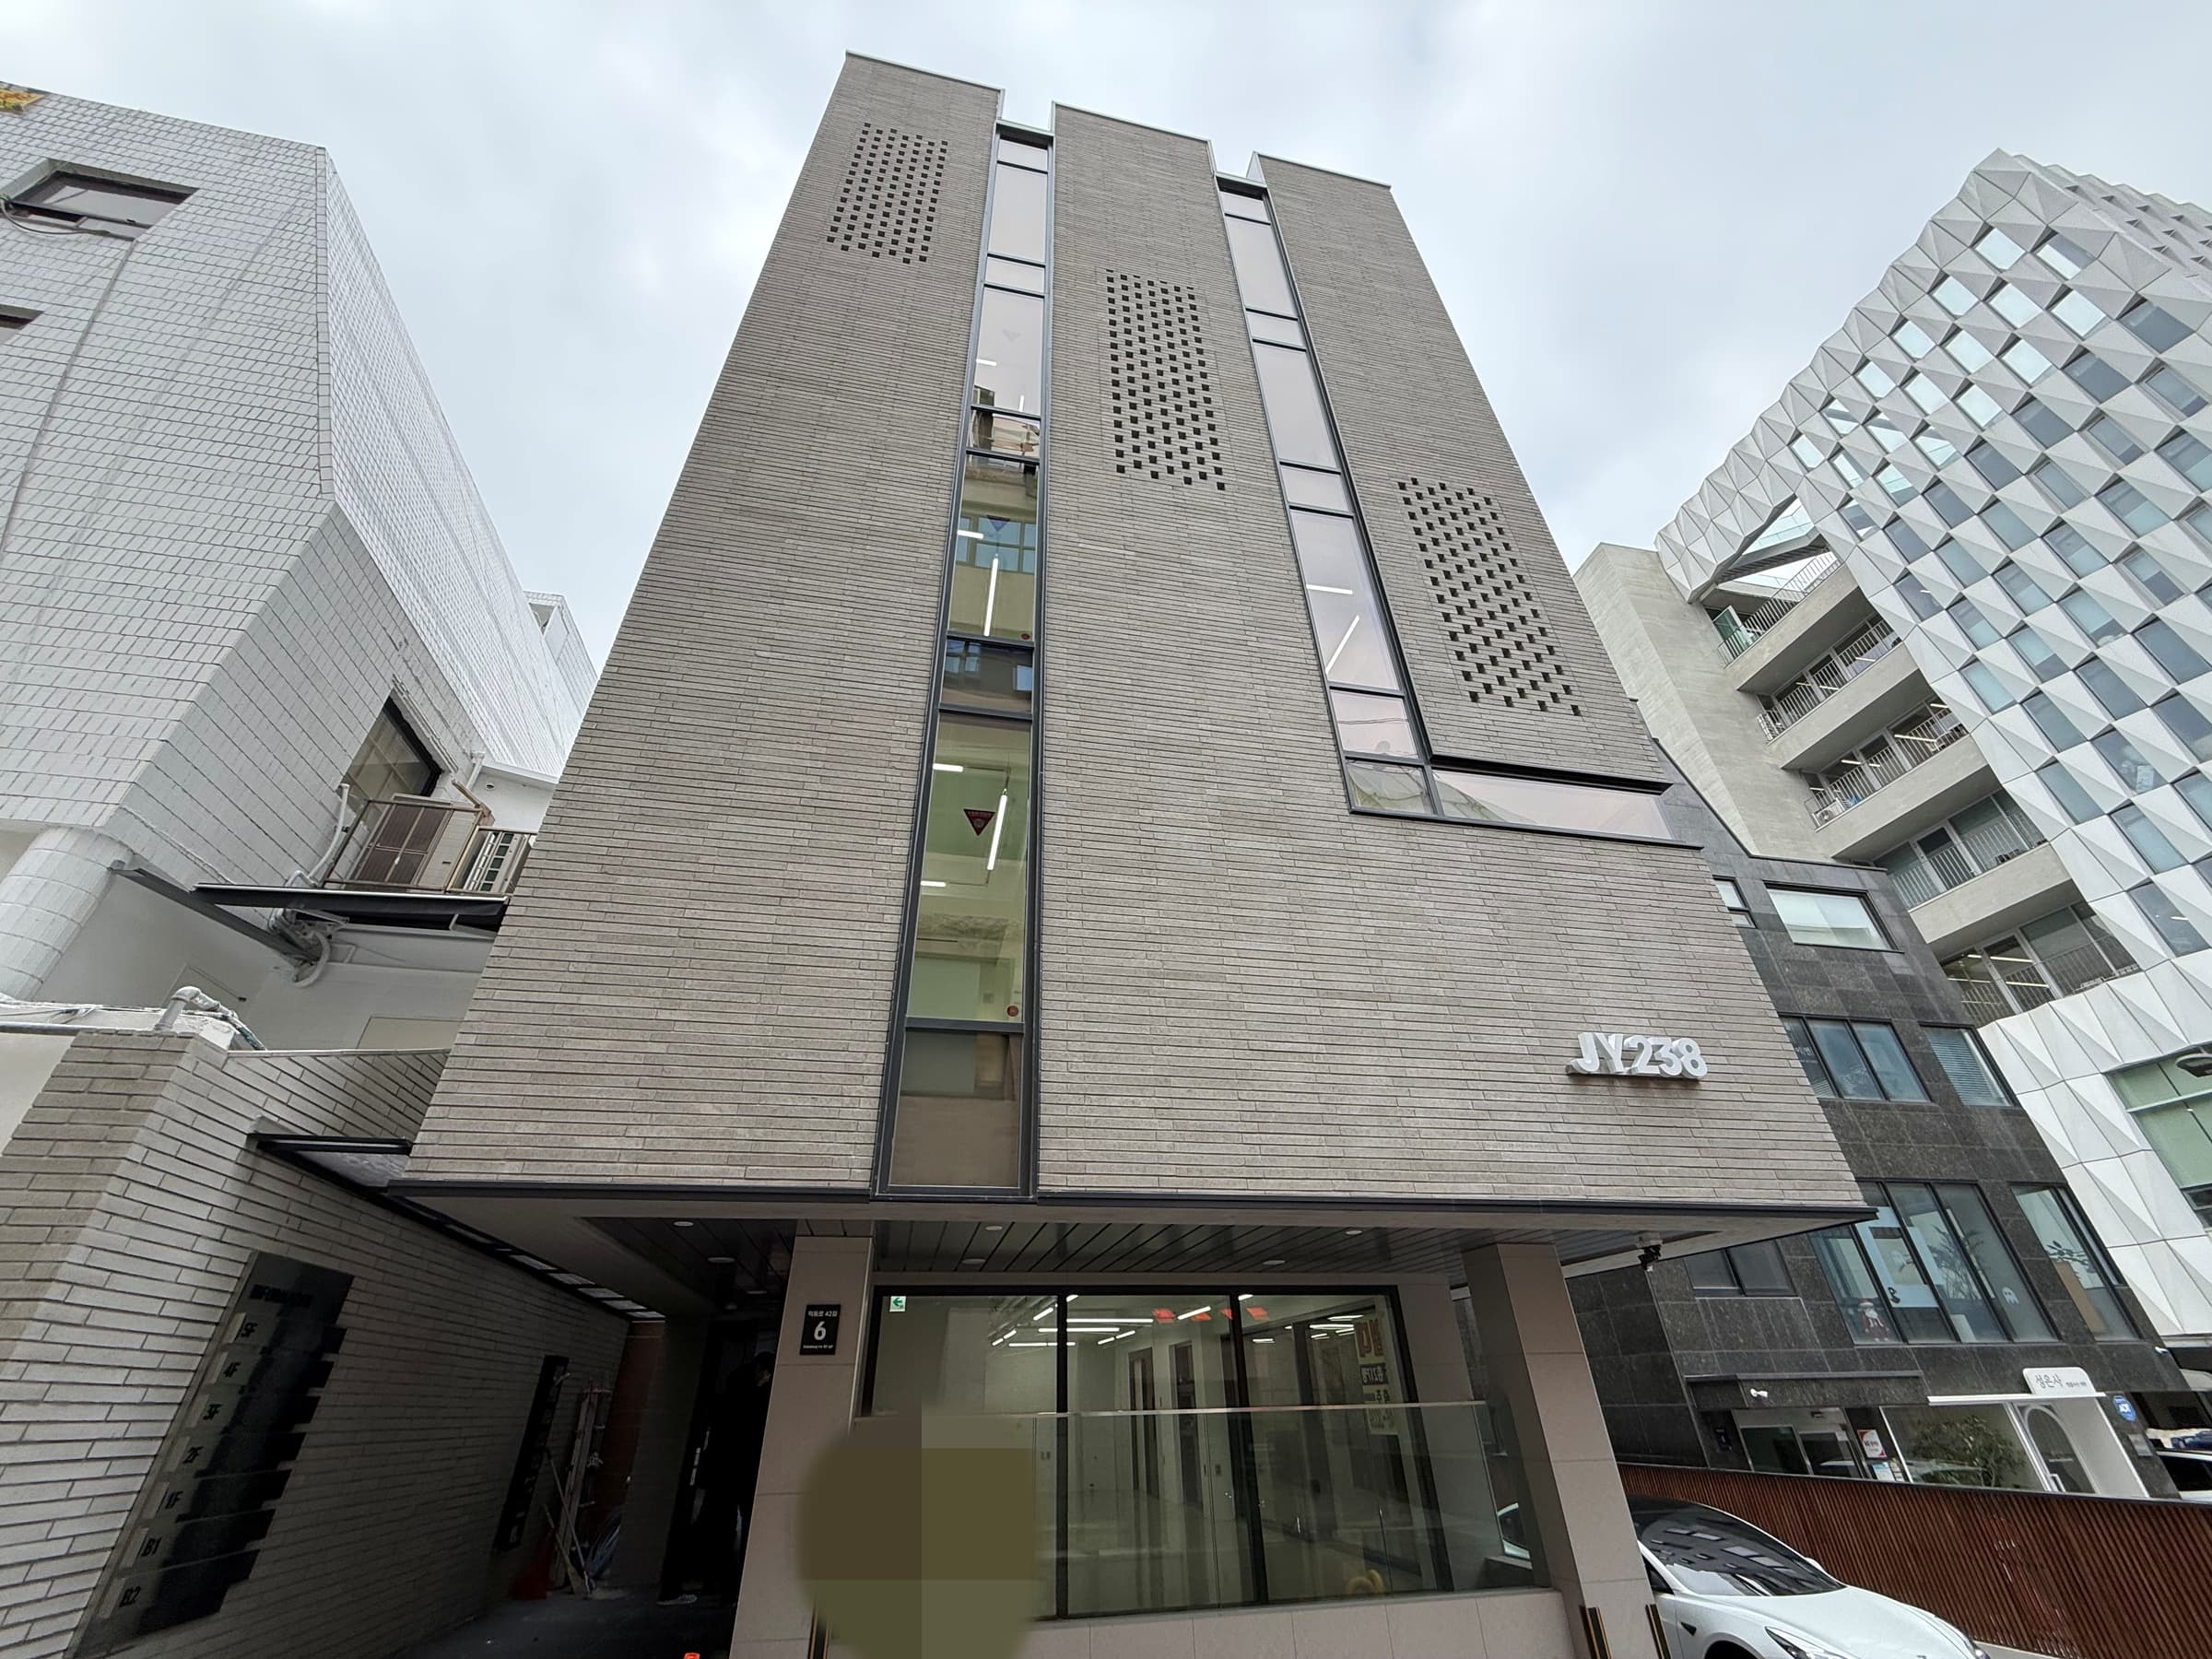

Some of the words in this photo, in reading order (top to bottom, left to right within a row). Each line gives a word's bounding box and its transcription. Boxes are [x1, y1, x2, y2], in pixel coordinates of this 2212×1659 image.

[1570, 1031, 1708, 1078] JY238
[241, 1322, 258, 1337] 5F
[813, 1321, 827, 1341] 6
[223, 1361, 241, 1379] 4F
[203, 1404, 223, 1420] 3F
[182, 1445, 204, 1465] 2F
[165, 1490, 184, 1510] 1F
[141, 1536, 163, 1558] B1
[118, 1585, 142, 1608] B2
